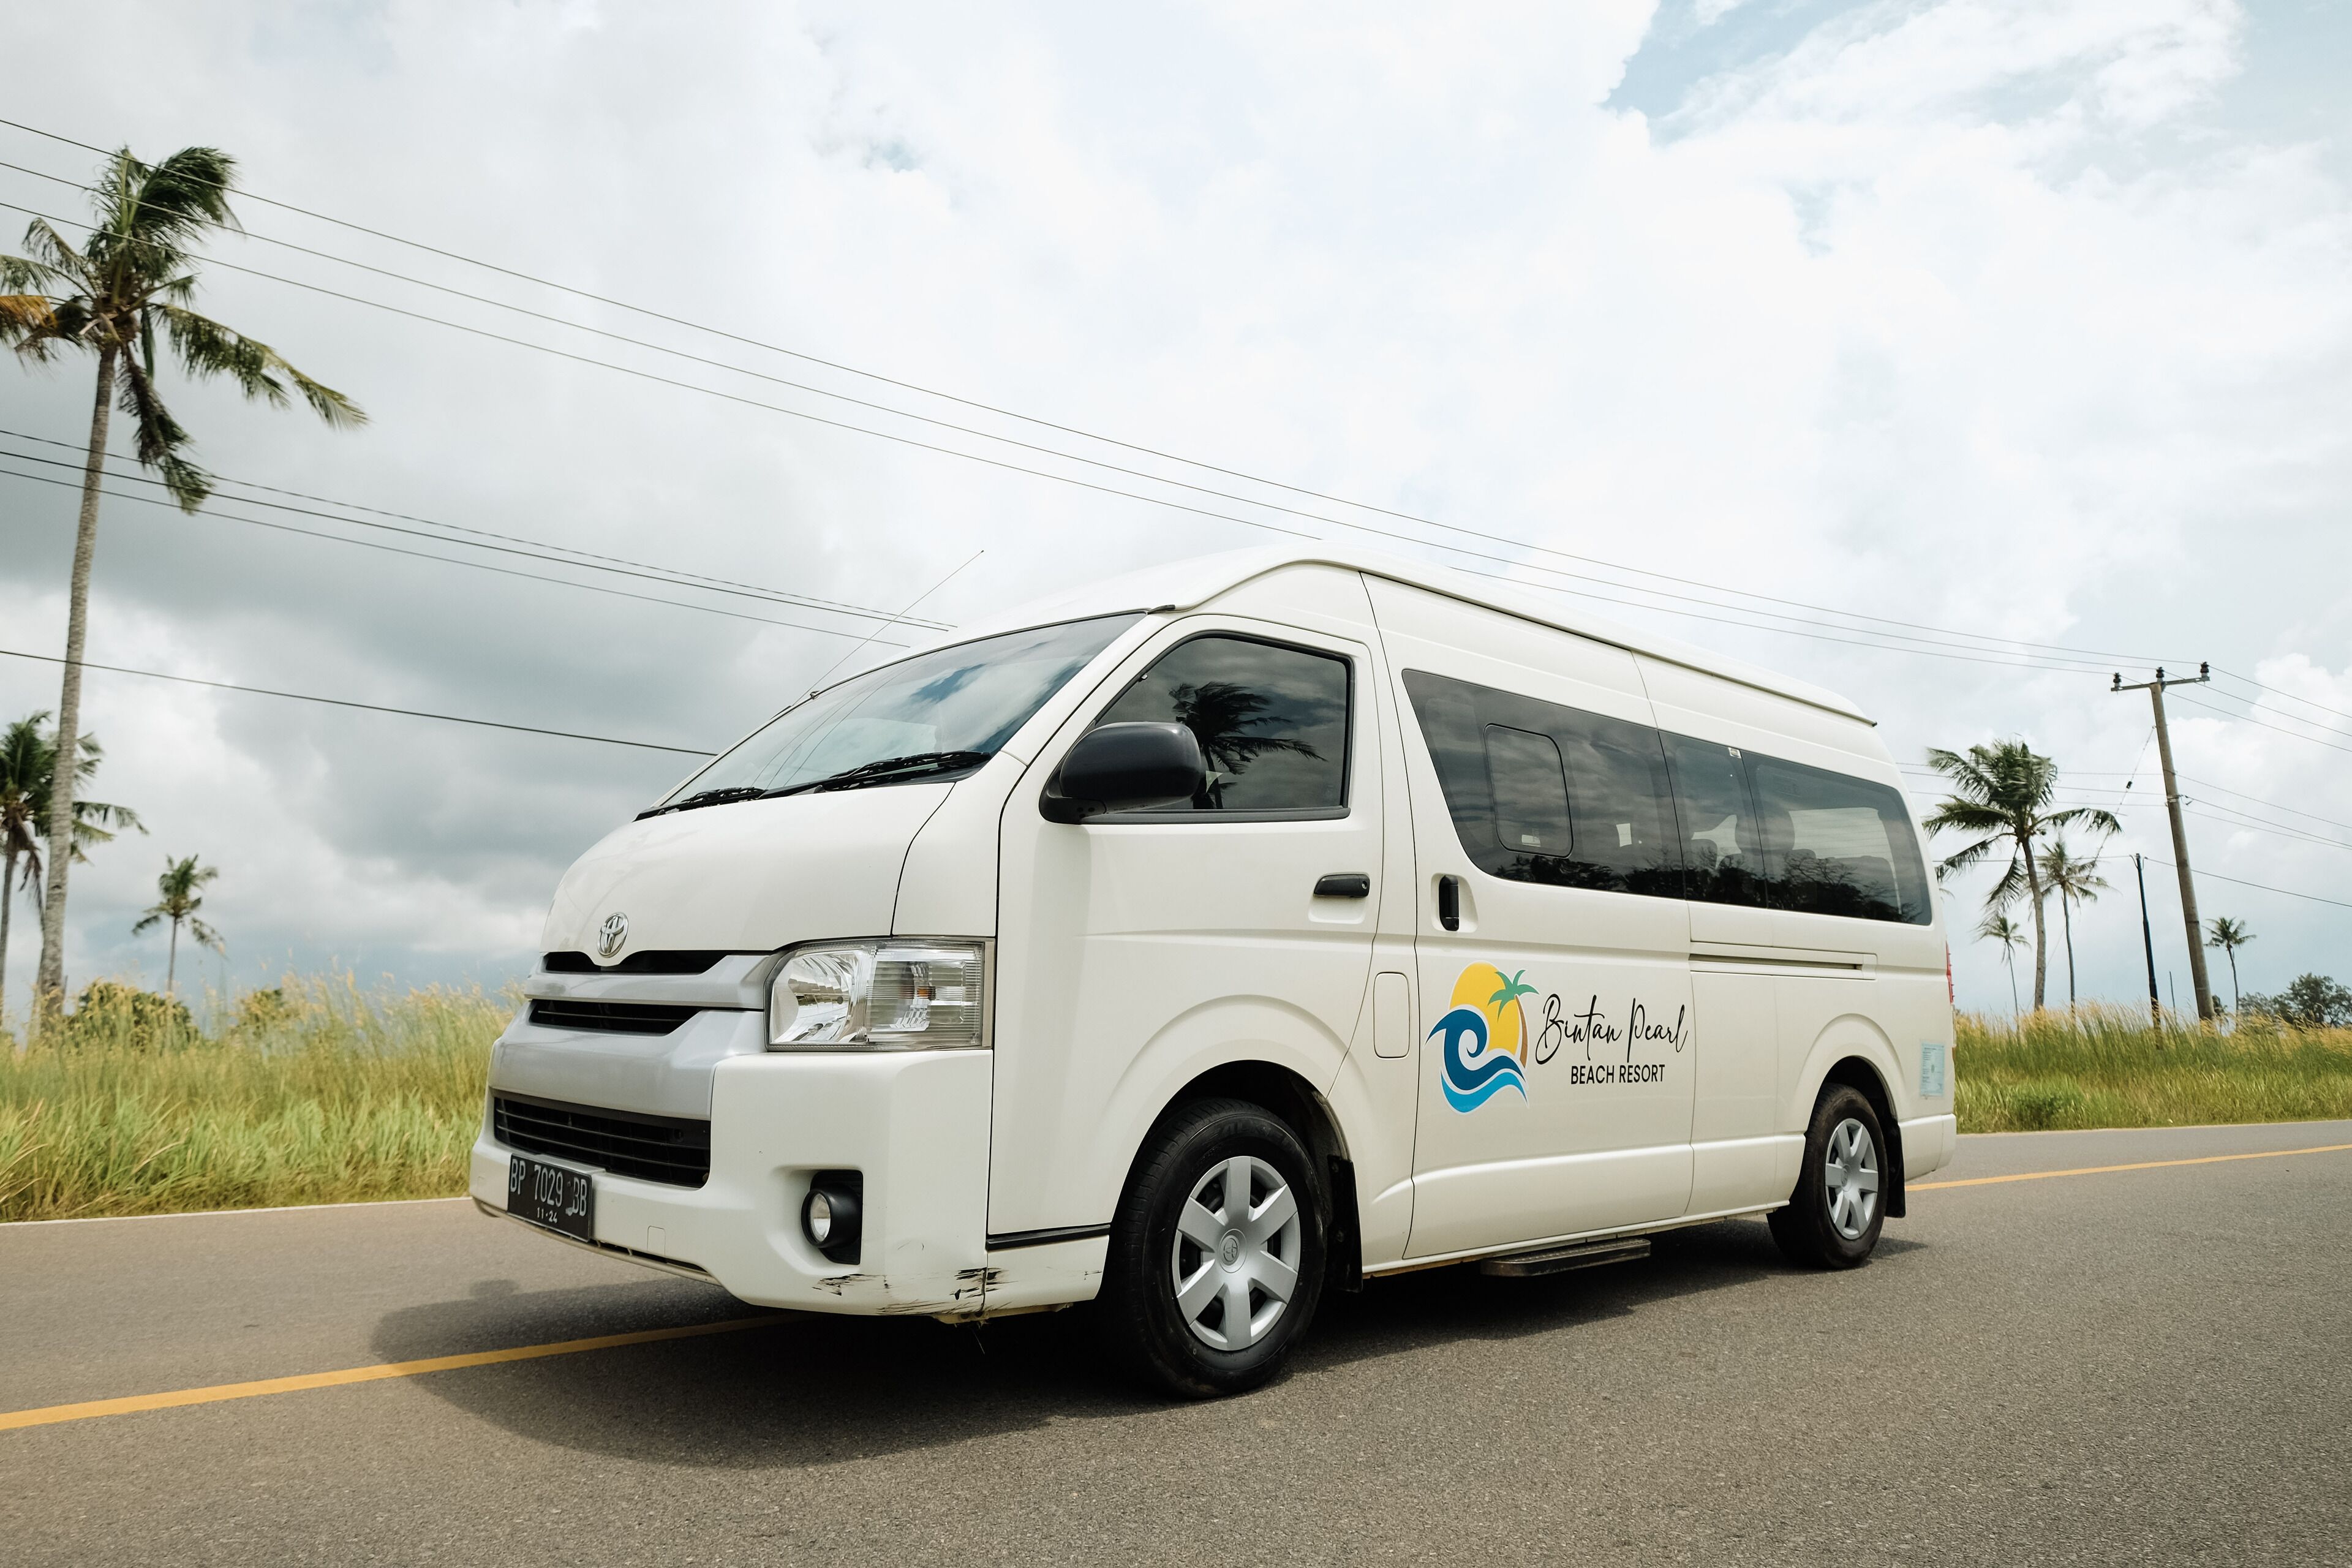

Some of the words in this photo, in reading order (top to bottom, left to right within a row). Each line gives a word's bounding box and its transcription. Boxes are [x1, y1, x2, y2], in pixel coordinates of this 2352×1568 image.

[1536, 993, 1622, 1065] Bintan
[1627, 998, 1688, 1063] Pearl
[1570, 1065, 1615, 1084] BEACH
[1619, 1065, 1665, 1083] RESORT
[510, 1159, 526, 1194] BP
[534, 1164, 563, 1207] 7029
